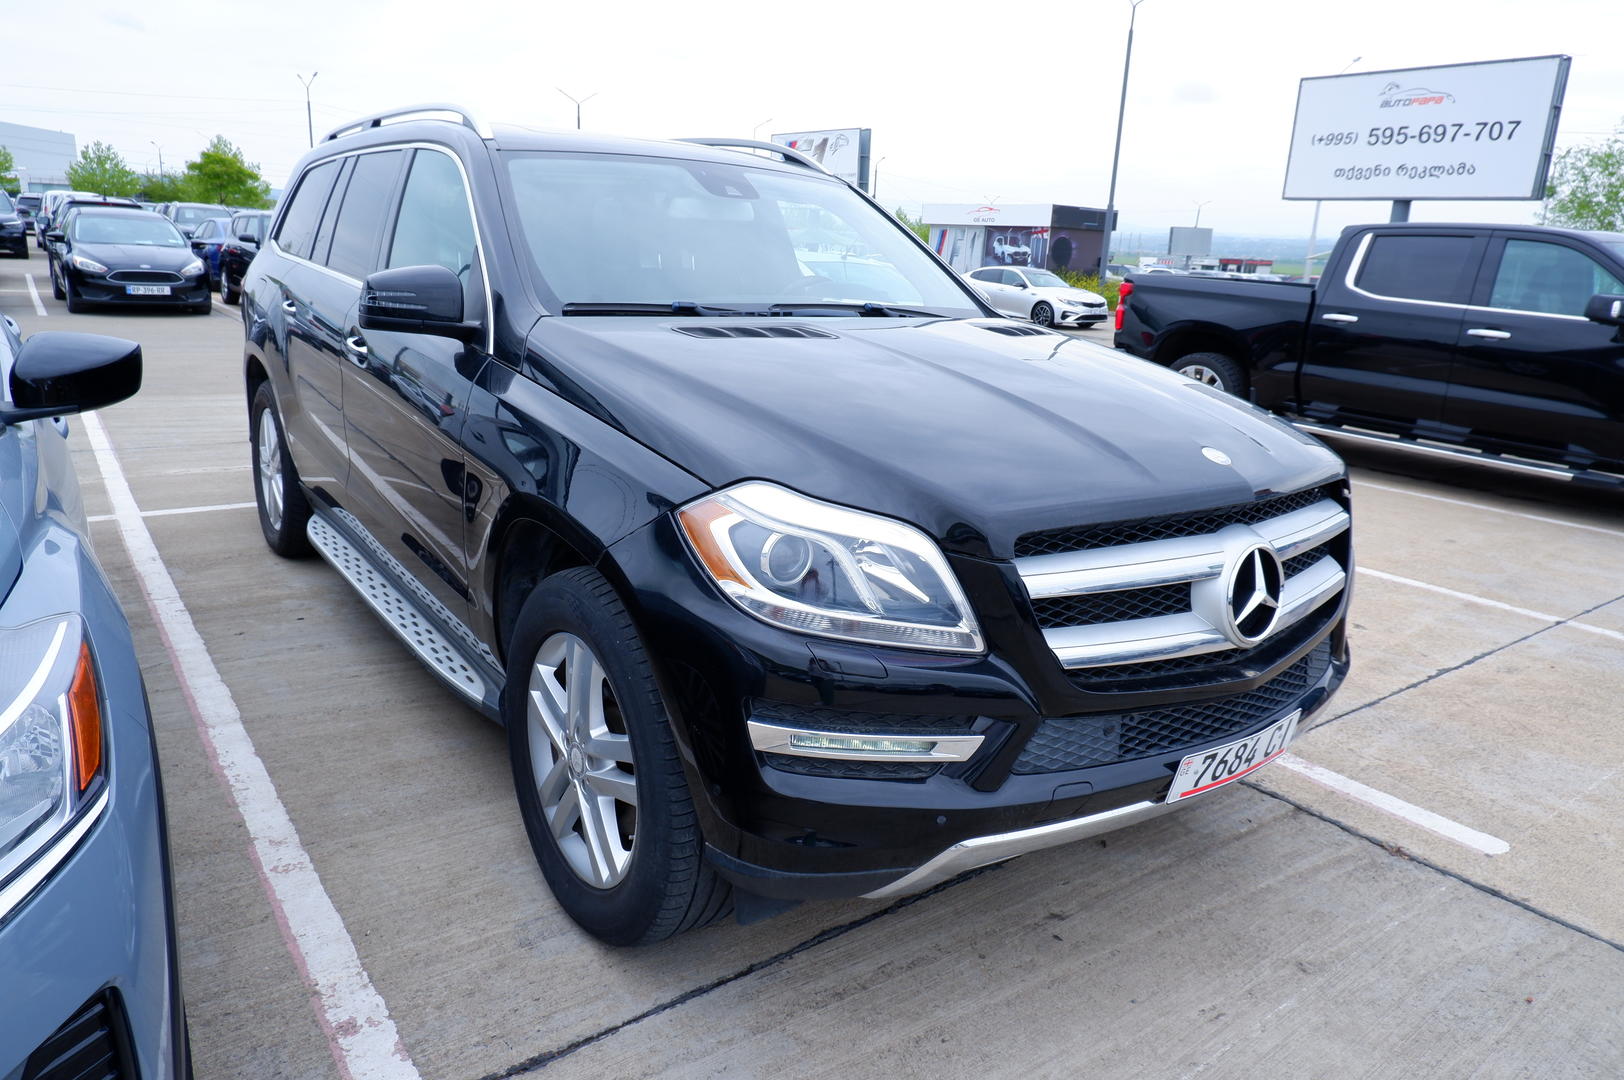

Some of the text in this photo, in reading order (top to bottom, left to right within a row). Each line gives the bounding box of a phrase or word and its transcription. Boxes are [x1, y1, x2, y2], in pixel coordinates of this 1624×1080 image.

[1311, 120, 1522, 146] (+995) 595-697-707
[1334, 162, 1476, 180] თქვენი რეკლამა
[1193, 736, 1261, 788] 7684
